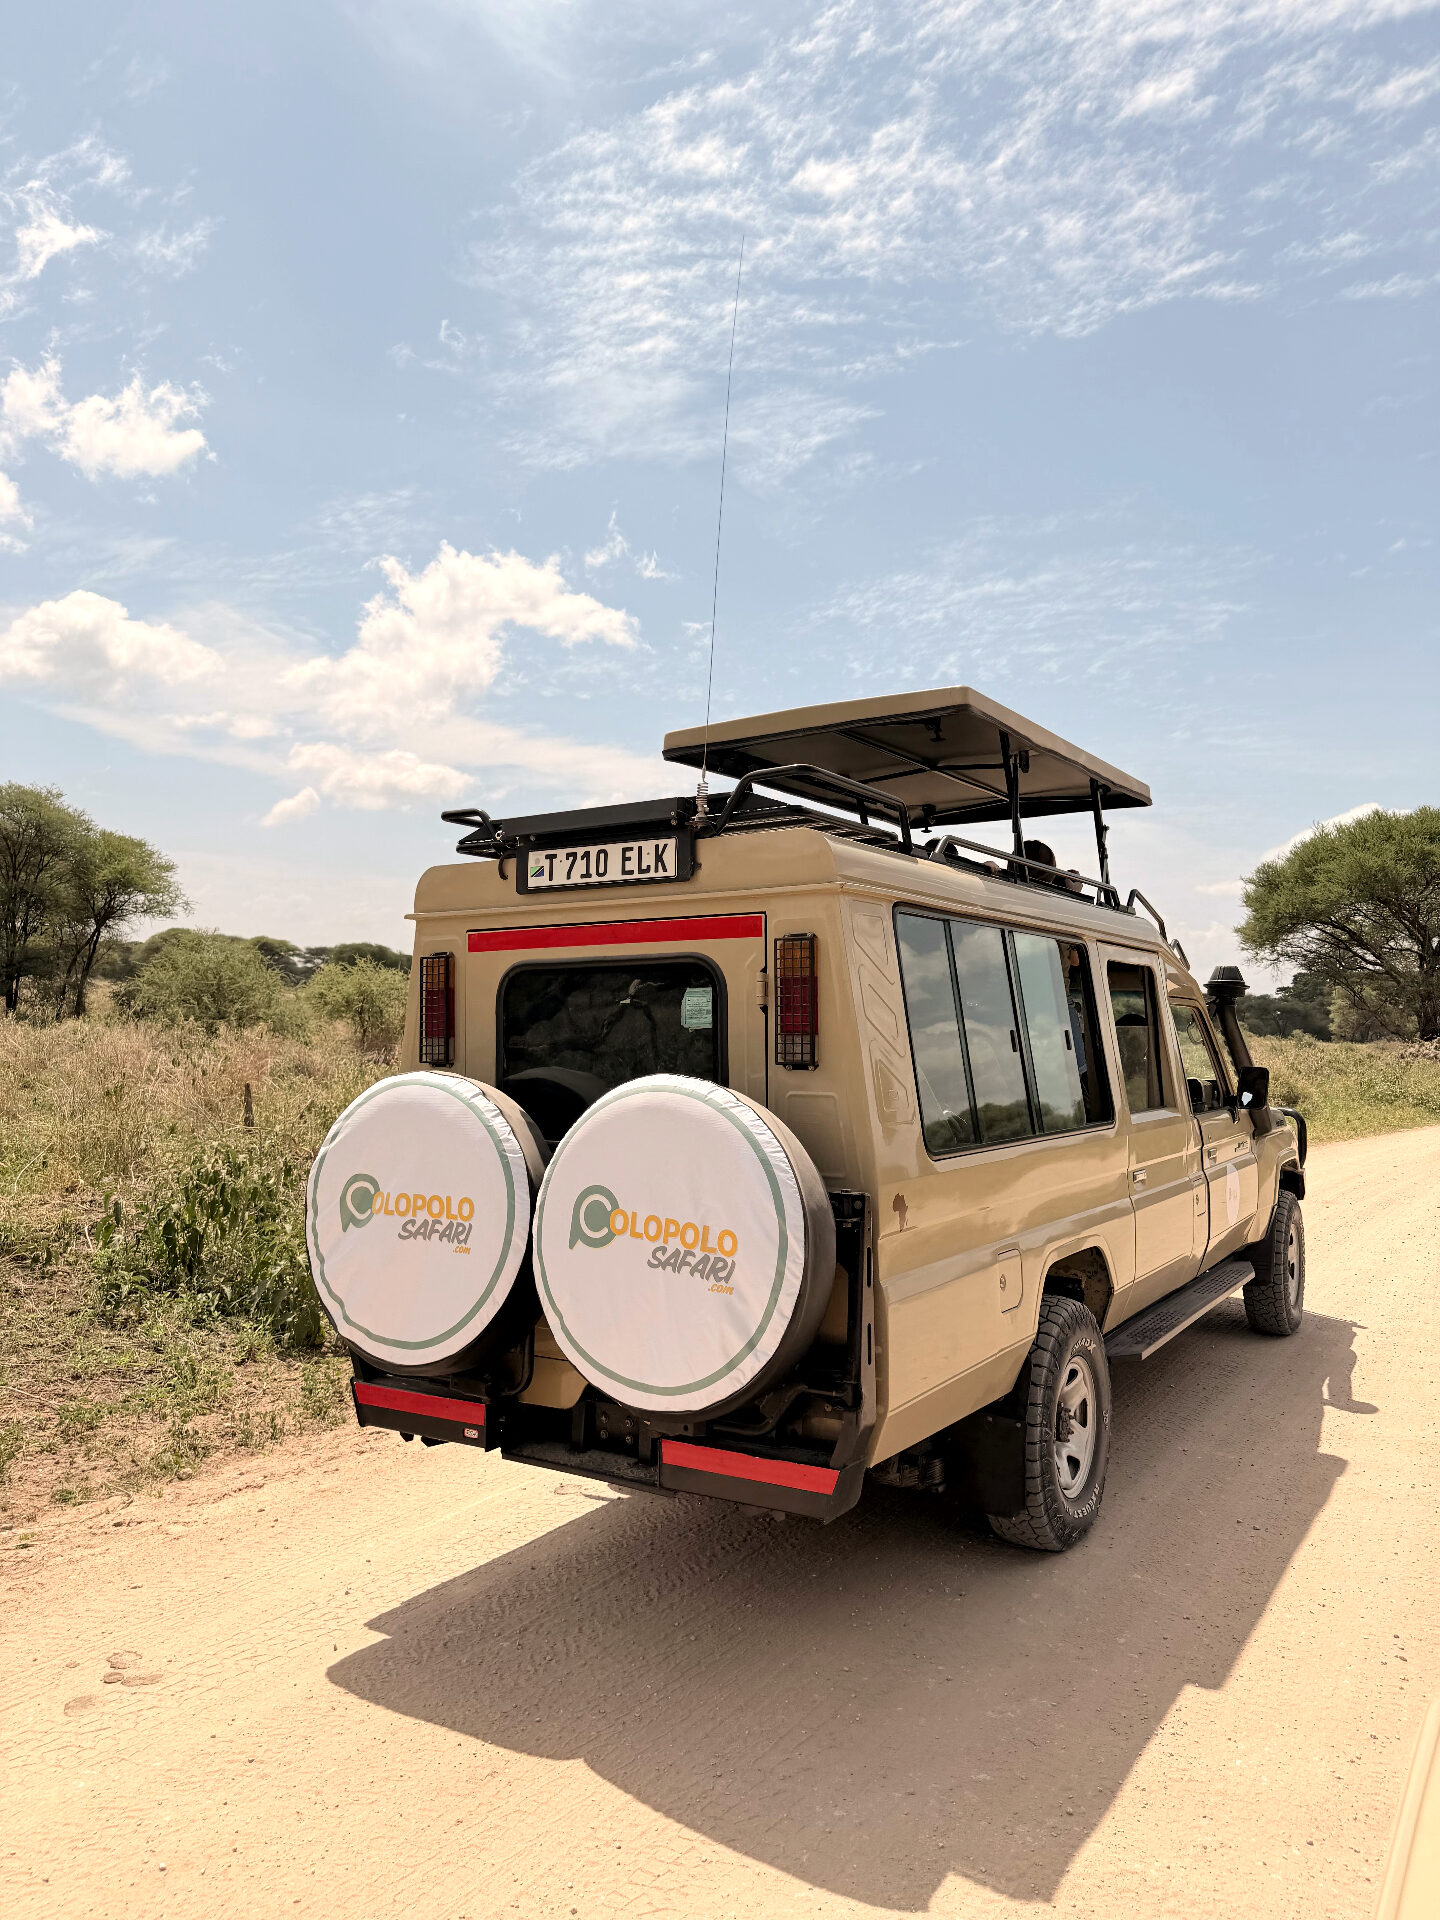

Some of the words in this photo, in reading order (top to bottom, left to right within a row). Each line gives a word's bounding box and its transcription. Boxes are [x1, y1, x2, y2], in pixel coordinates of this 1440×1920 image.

[544, 853, 558, 882] T
[565, 848, 609, 881] 710
[621, 843, 669, 876] ELK
[397, 1218, 473, 1246] SAFARI
[646, 1245, 737, 1284] SAFARI
